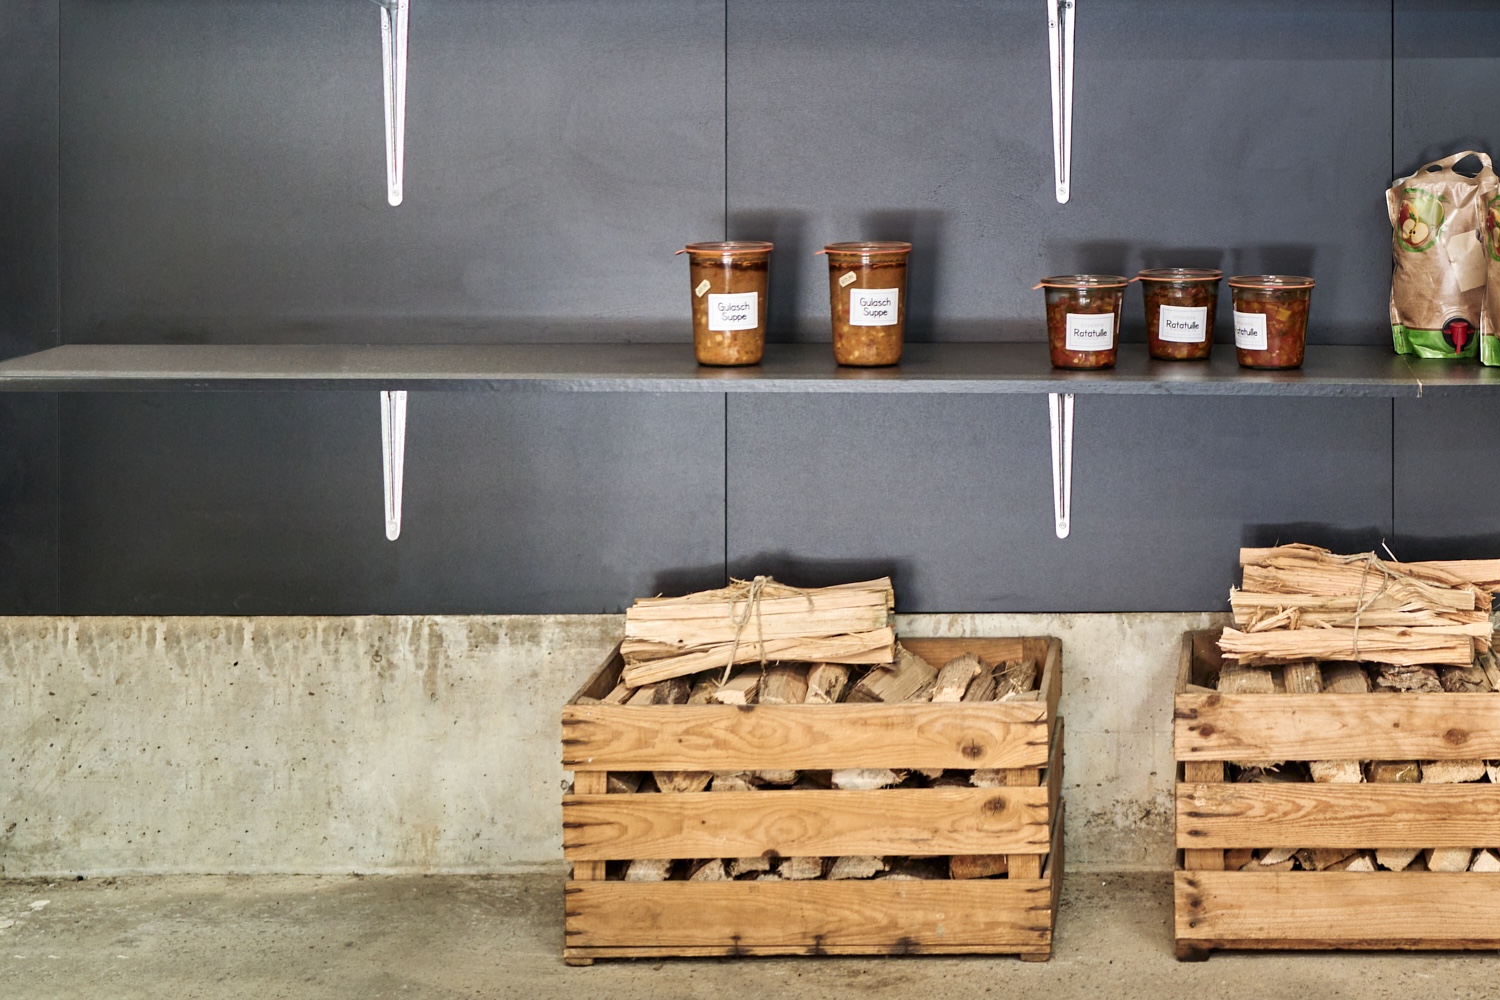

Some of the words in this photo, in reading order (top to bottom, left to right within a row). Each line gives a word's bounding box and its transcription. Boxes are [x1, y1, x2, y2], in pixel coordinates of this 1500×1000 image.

[717, 301, 750, 312] Gulasch
[860, 297, 892, 307] Gulasch
[721, 311, 747, 323] Suppe
[863, 307, 888, 318] Suppe
